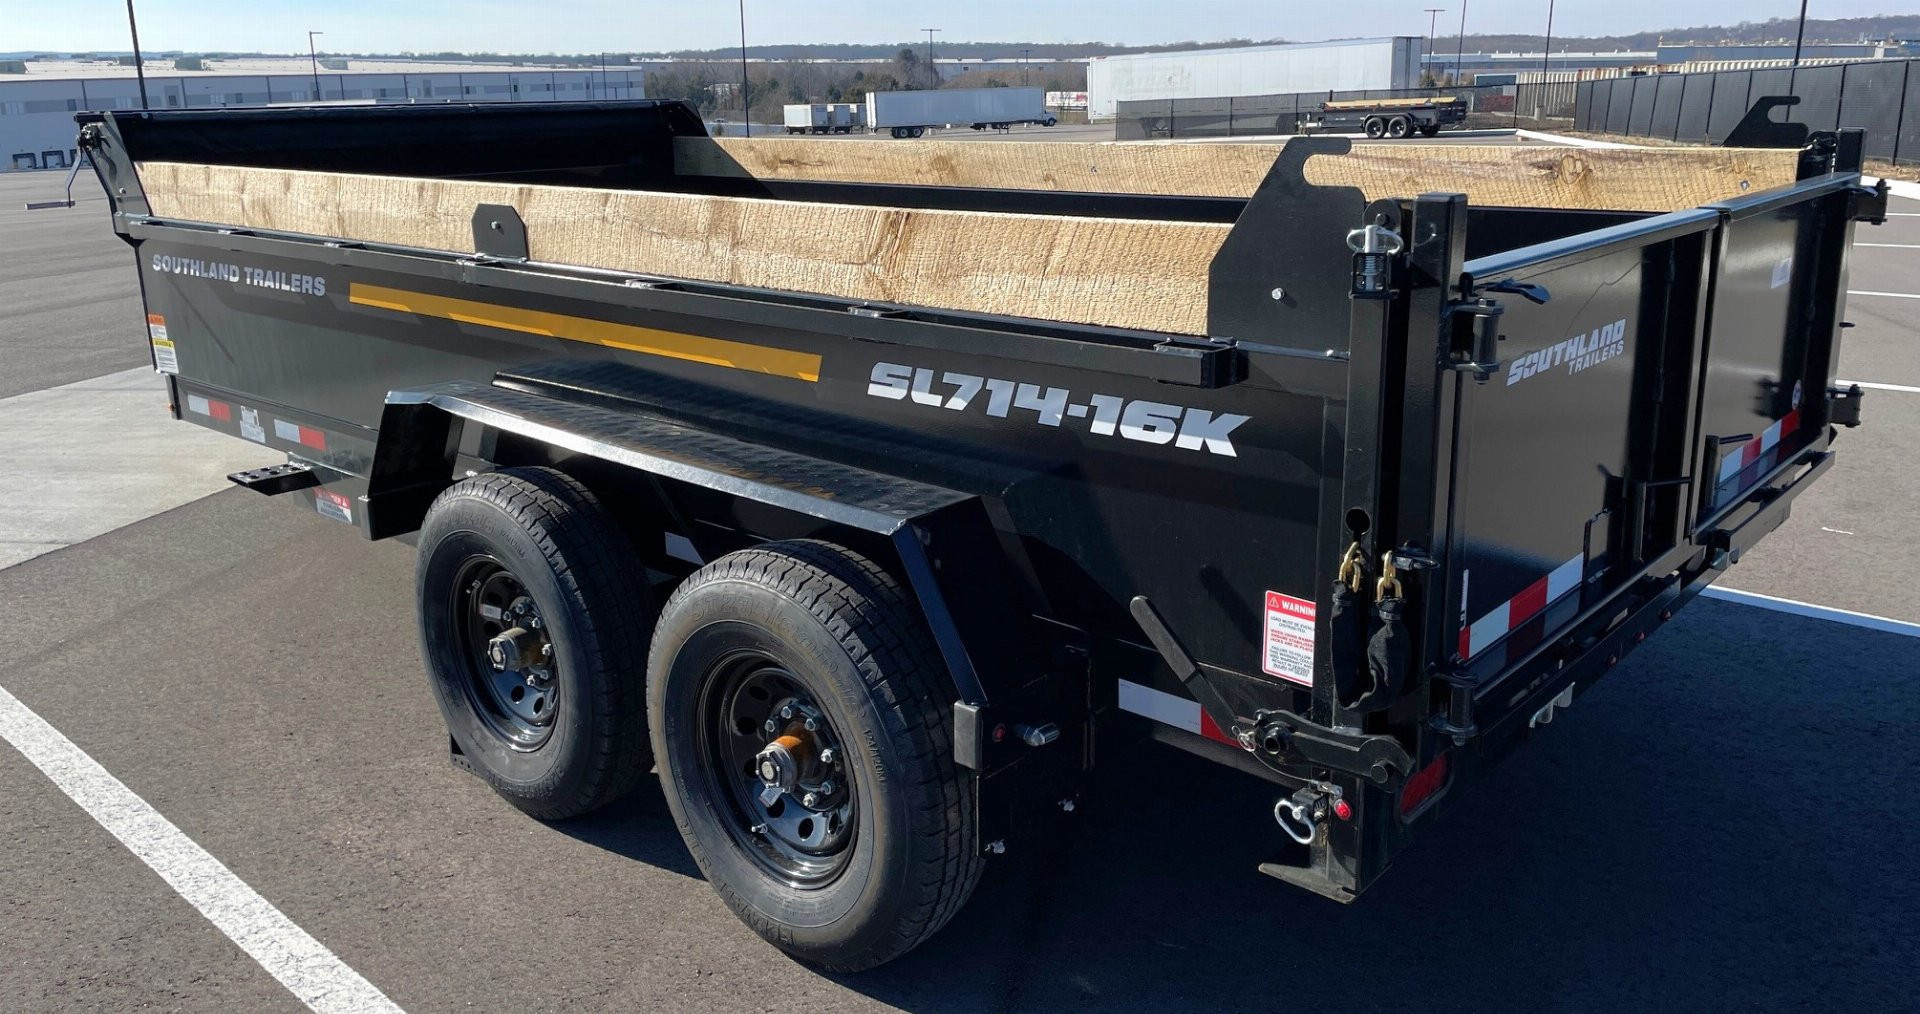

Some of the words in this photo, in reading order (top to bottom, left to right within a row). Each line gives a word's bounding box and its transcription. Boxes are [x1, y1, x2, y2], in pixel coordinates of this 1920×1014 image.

[152, 254, 240, 283] SOUTHLAND
[243, 266, 326, 297] TRAILERS
[1506, 318, 1626, 387] SOUTHLAND
[1568, 340, 1624, 376] TRAILERS
[866, 361, 1253, 458] SL714-16K
[1281, 600, 1316, 617] WARNIN
